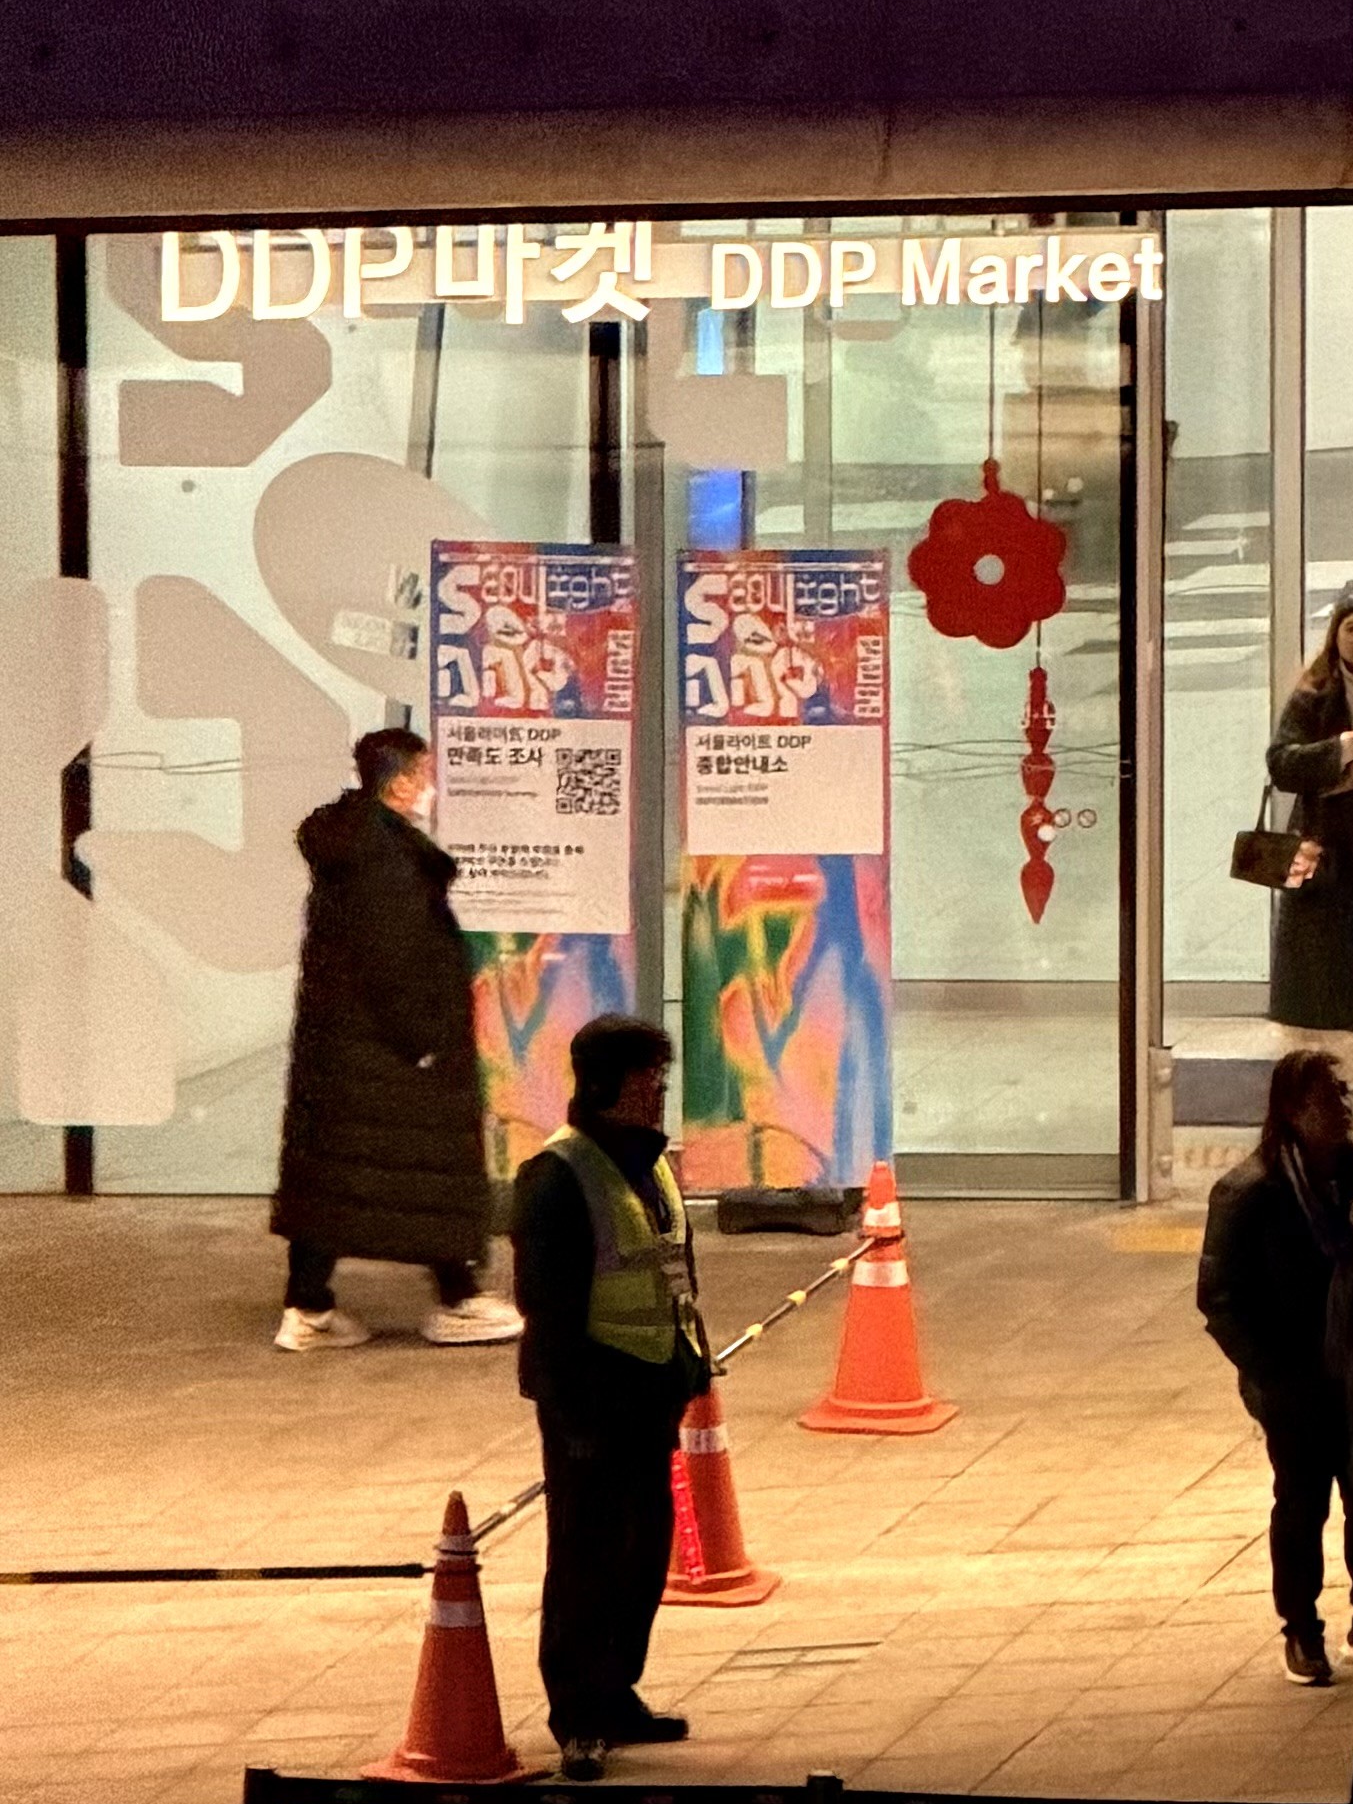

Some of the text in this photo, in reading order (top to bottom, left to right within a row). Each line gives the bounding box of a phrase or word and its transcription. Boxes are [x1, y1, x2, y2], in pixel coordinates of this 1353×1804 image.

[161, 221, 1164, 324] DDP마켓 DDP Market
[695, 733, 812, 751] 서울라이트 DDP
[508, 746, 543, 768] 조사
[695, 754, 789, 775] 종합안내소
